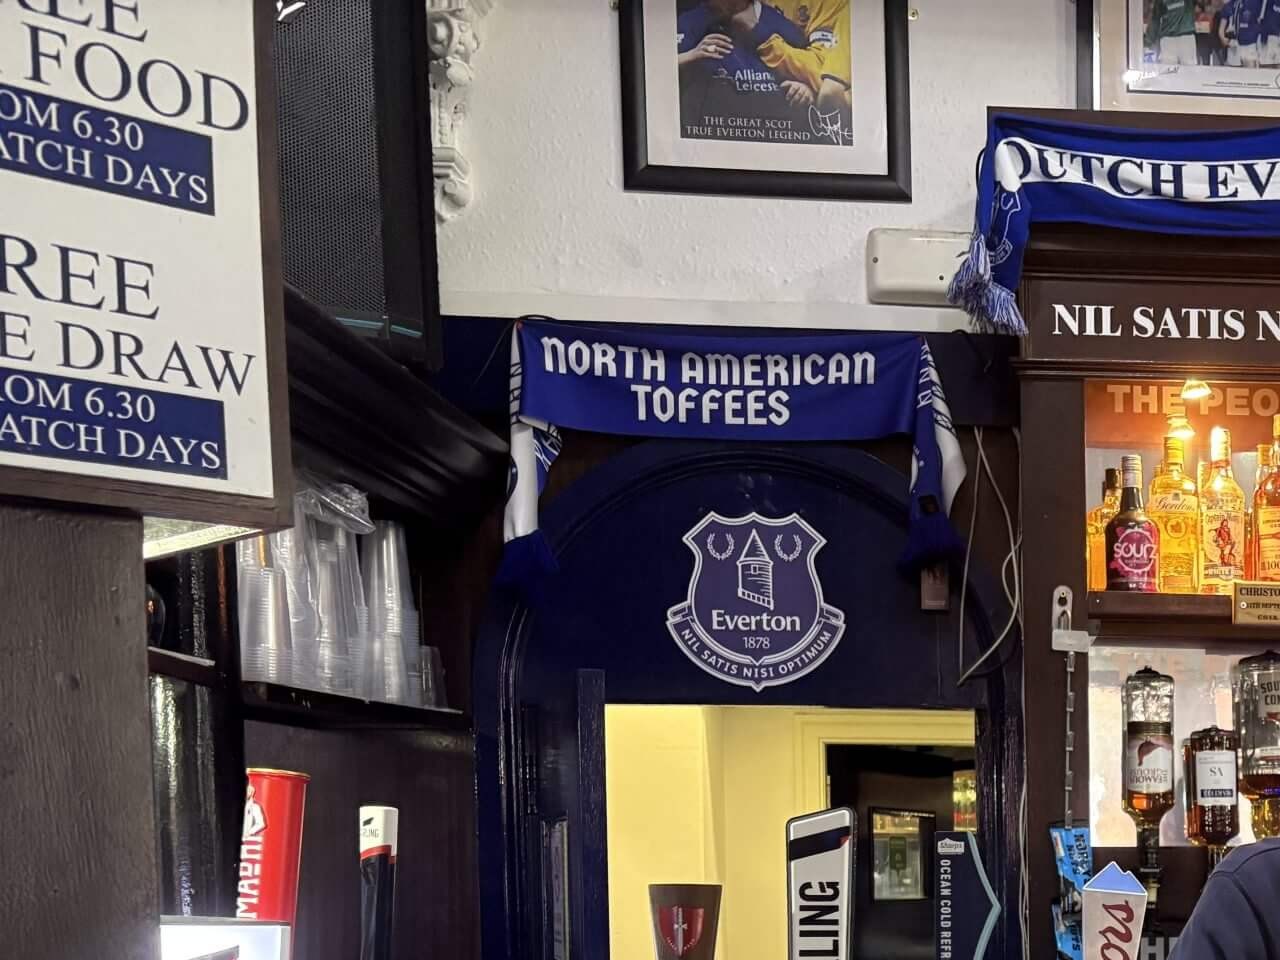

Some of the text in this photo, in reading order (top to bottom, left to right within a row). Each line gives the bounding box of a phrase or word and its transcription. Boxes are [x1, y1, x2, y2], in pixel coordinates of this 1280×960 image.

[21, 21, 249, 131] FOOD
[0, 88, 144, 151] OM 6.30
[686, 125, 811, 141] TRUE EVERTON LEGEND
[704, 116, 793, 129] THE GREAT SCOT
[104, 154, 208, 203] DAYS
[0, 233, 160, 320] REE
[1052, 304, 1122, 337] NIL
[1133, 307, 1245, 340] SATIS
[55, 320, 256, 396] DRAW
[541, 335, 877, 387] NORTH AMERICAN
[1, 374, 155, 422] OM 6.30
[631, 384, 791, 426] TOFFEES
[1106, 384, 1187, 414] THE
[0, 413, 221, 469] ATCH DAYS
[711, 609, 800, 631] Everton
[743, 636, 770, 649] 1878
[681, 629, 832, 678] NIL SATIS NISI OPTIMUM
[940, 859, 951, 896] OCEAN
[940, 900, 951, 928] COLD
